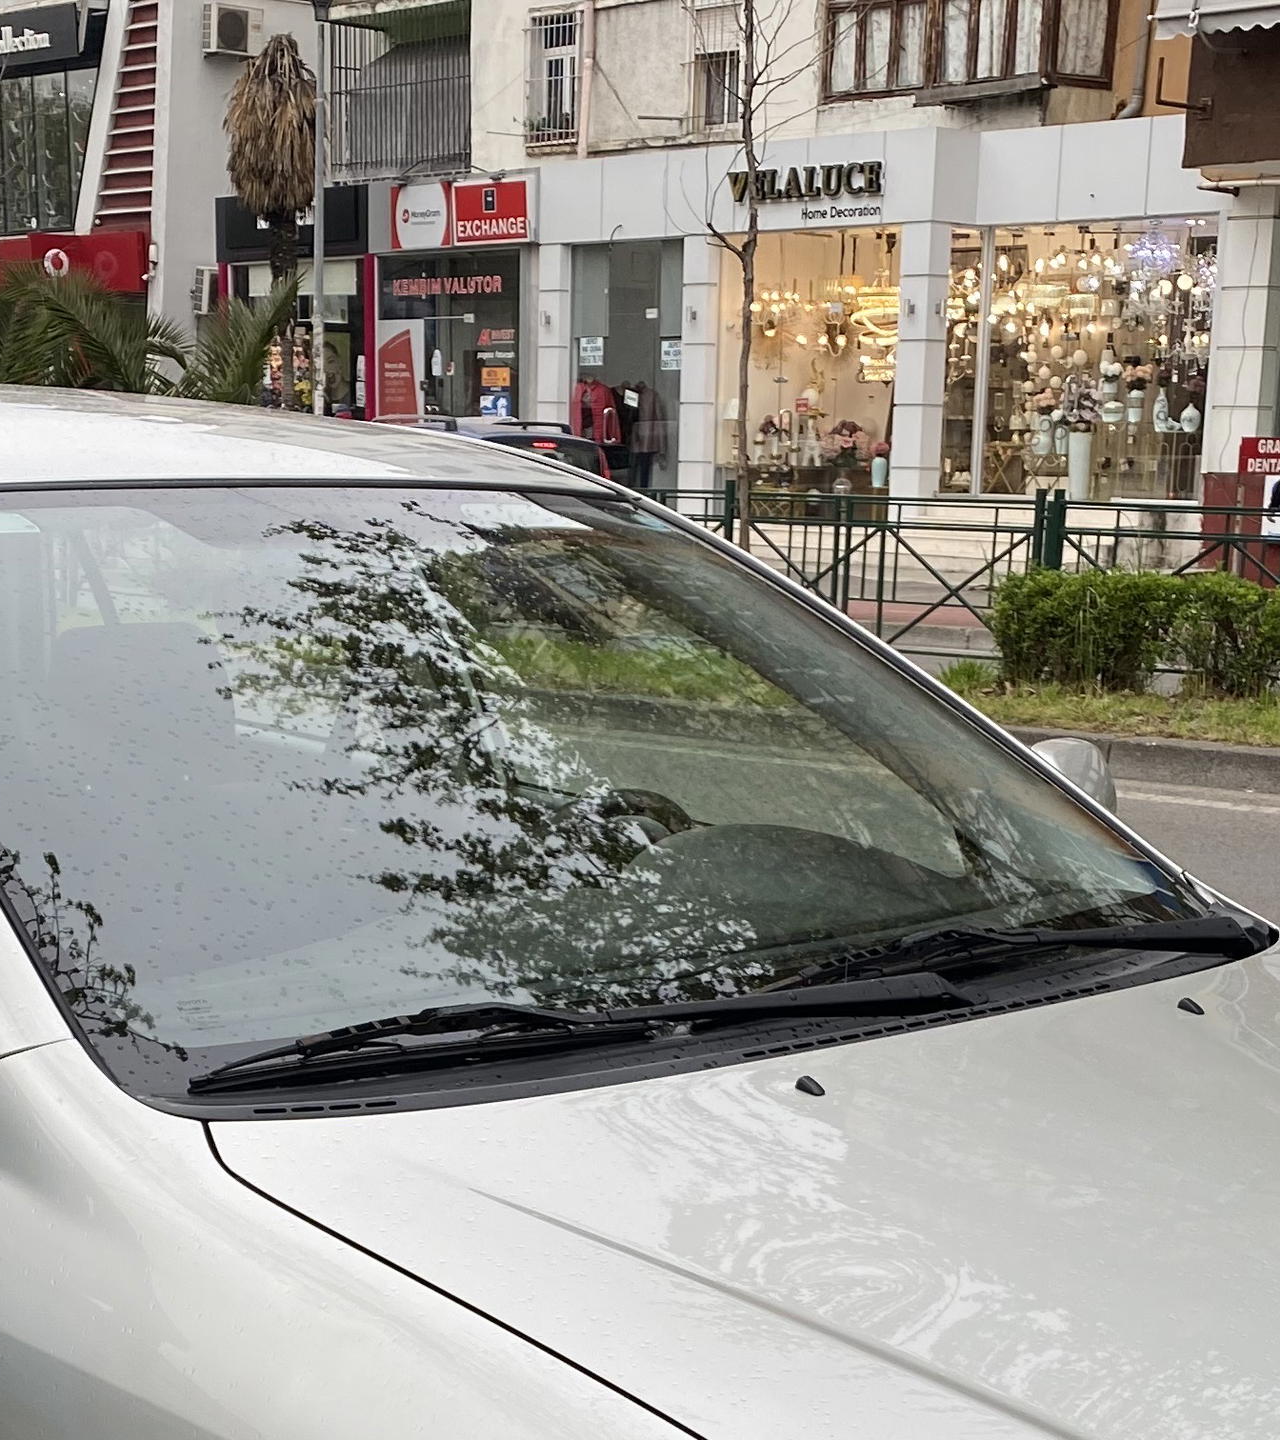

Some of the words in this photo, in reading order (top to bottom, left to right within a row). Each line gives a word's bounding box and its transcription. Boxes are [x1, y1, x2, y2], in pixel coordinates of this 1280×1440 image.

[801, 208, 827, 219] Home
[830, 206, 881, 218] Decoration
[457, 217, 525, 238] EXCHANGE
[393, 278, 440, 296] KEMBIM
[443, 275, 502, 294] VALUTOR
